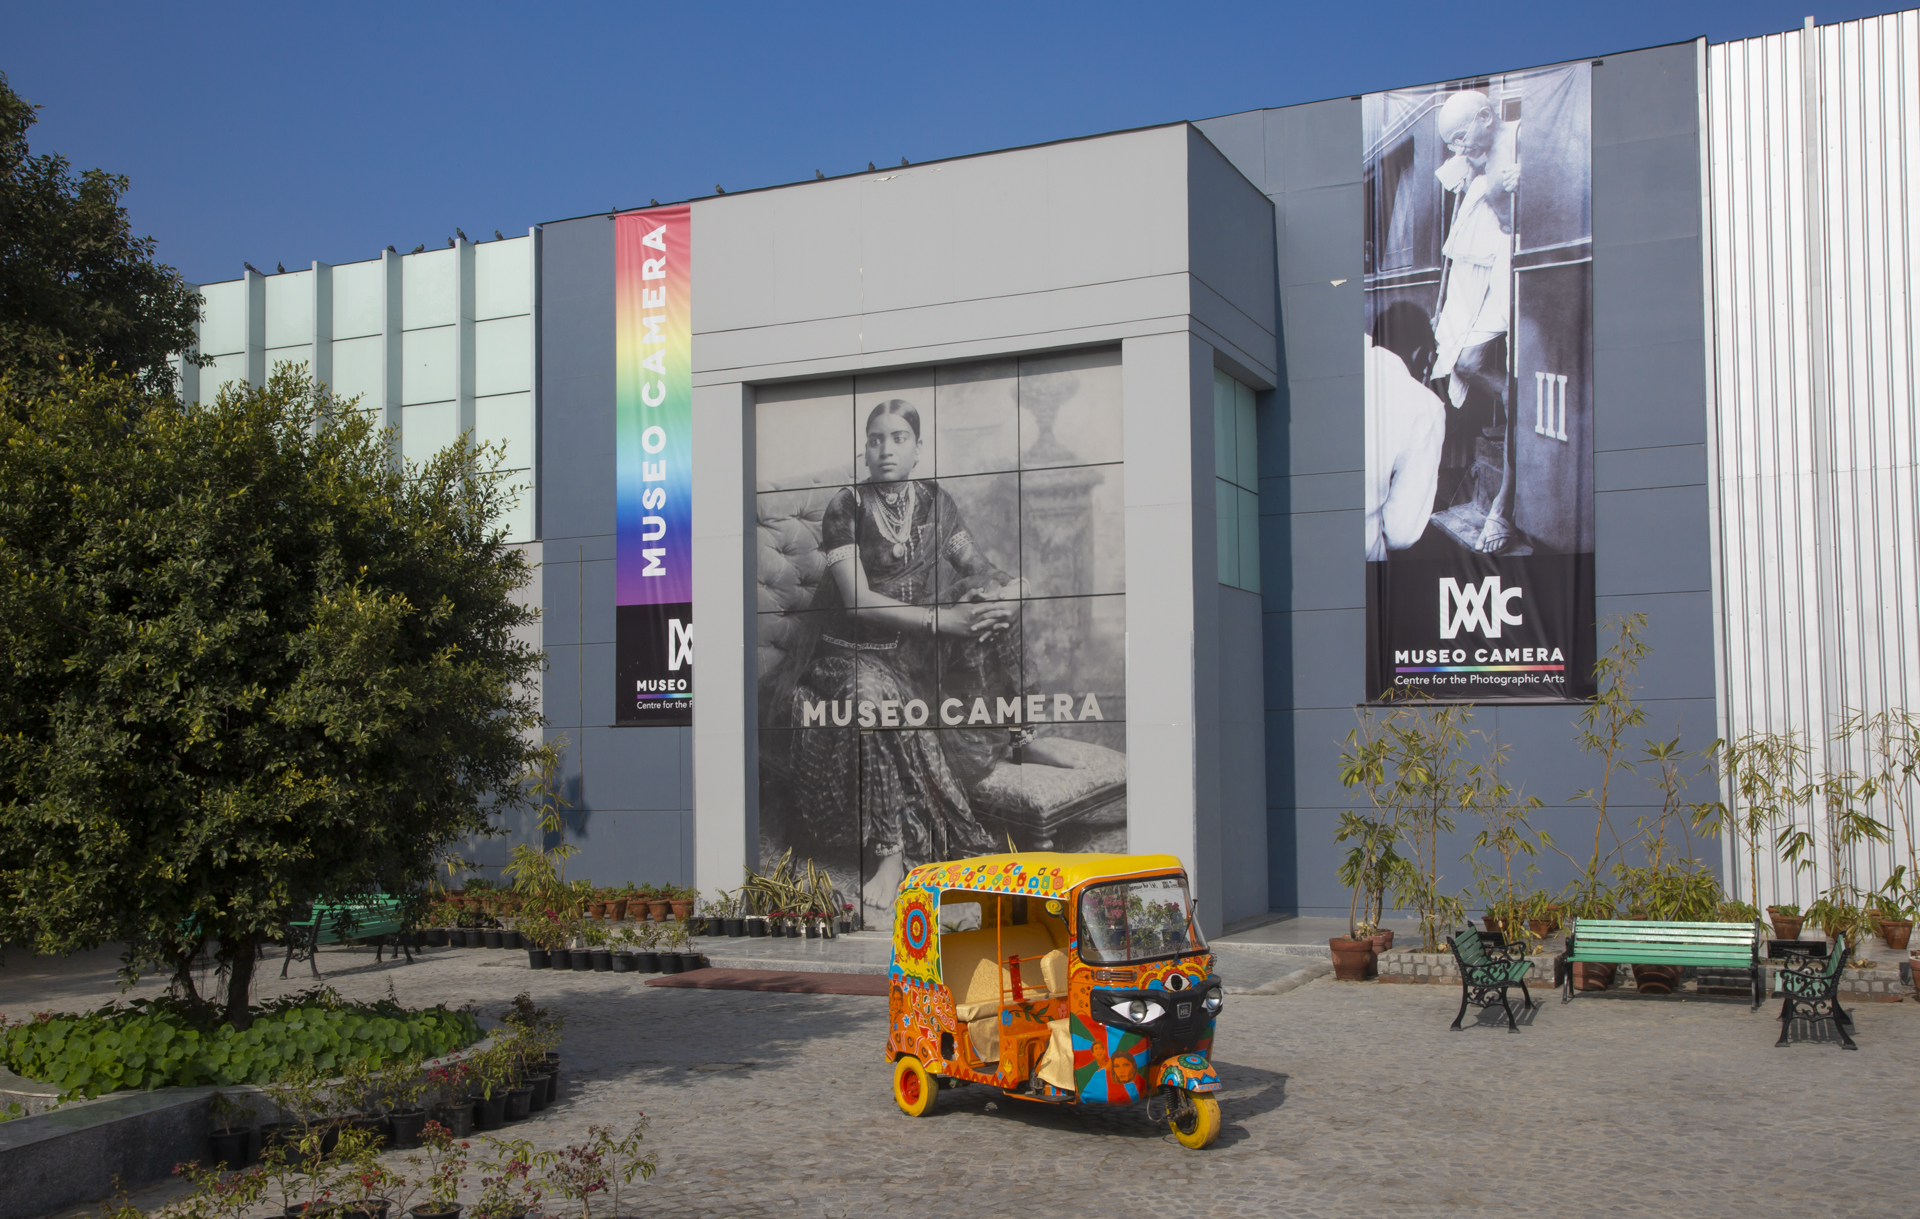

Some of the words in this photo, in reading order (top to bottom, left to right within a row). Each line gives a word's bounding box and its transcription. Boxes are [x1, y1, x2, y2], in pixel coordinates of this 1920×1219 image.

[641, 224, 667, 407] CAMERA
[641, 425, 667, 577] MUSEO
[1395, 648, 1467, 664] MUSEO
[1474, 647, 1565, 663] CAMERA
[637, 679, 687, 691] MUSEO
[1395, 674, 1430, 686] Centre
[1432, 673, 1448, 685] for
[1450, 674, 1467, 684] the
[1469, 673, 1540, 687] Photographic
[1542, 673, 1566, 684] Arts
[637, 701, 661, 709] Centre
[662, 701, 673, 709] for
[675, 700, 687, 708] the
[803, 698, 930, 727] MUSEO
[940, 692, 1105, 726] CAMERA
